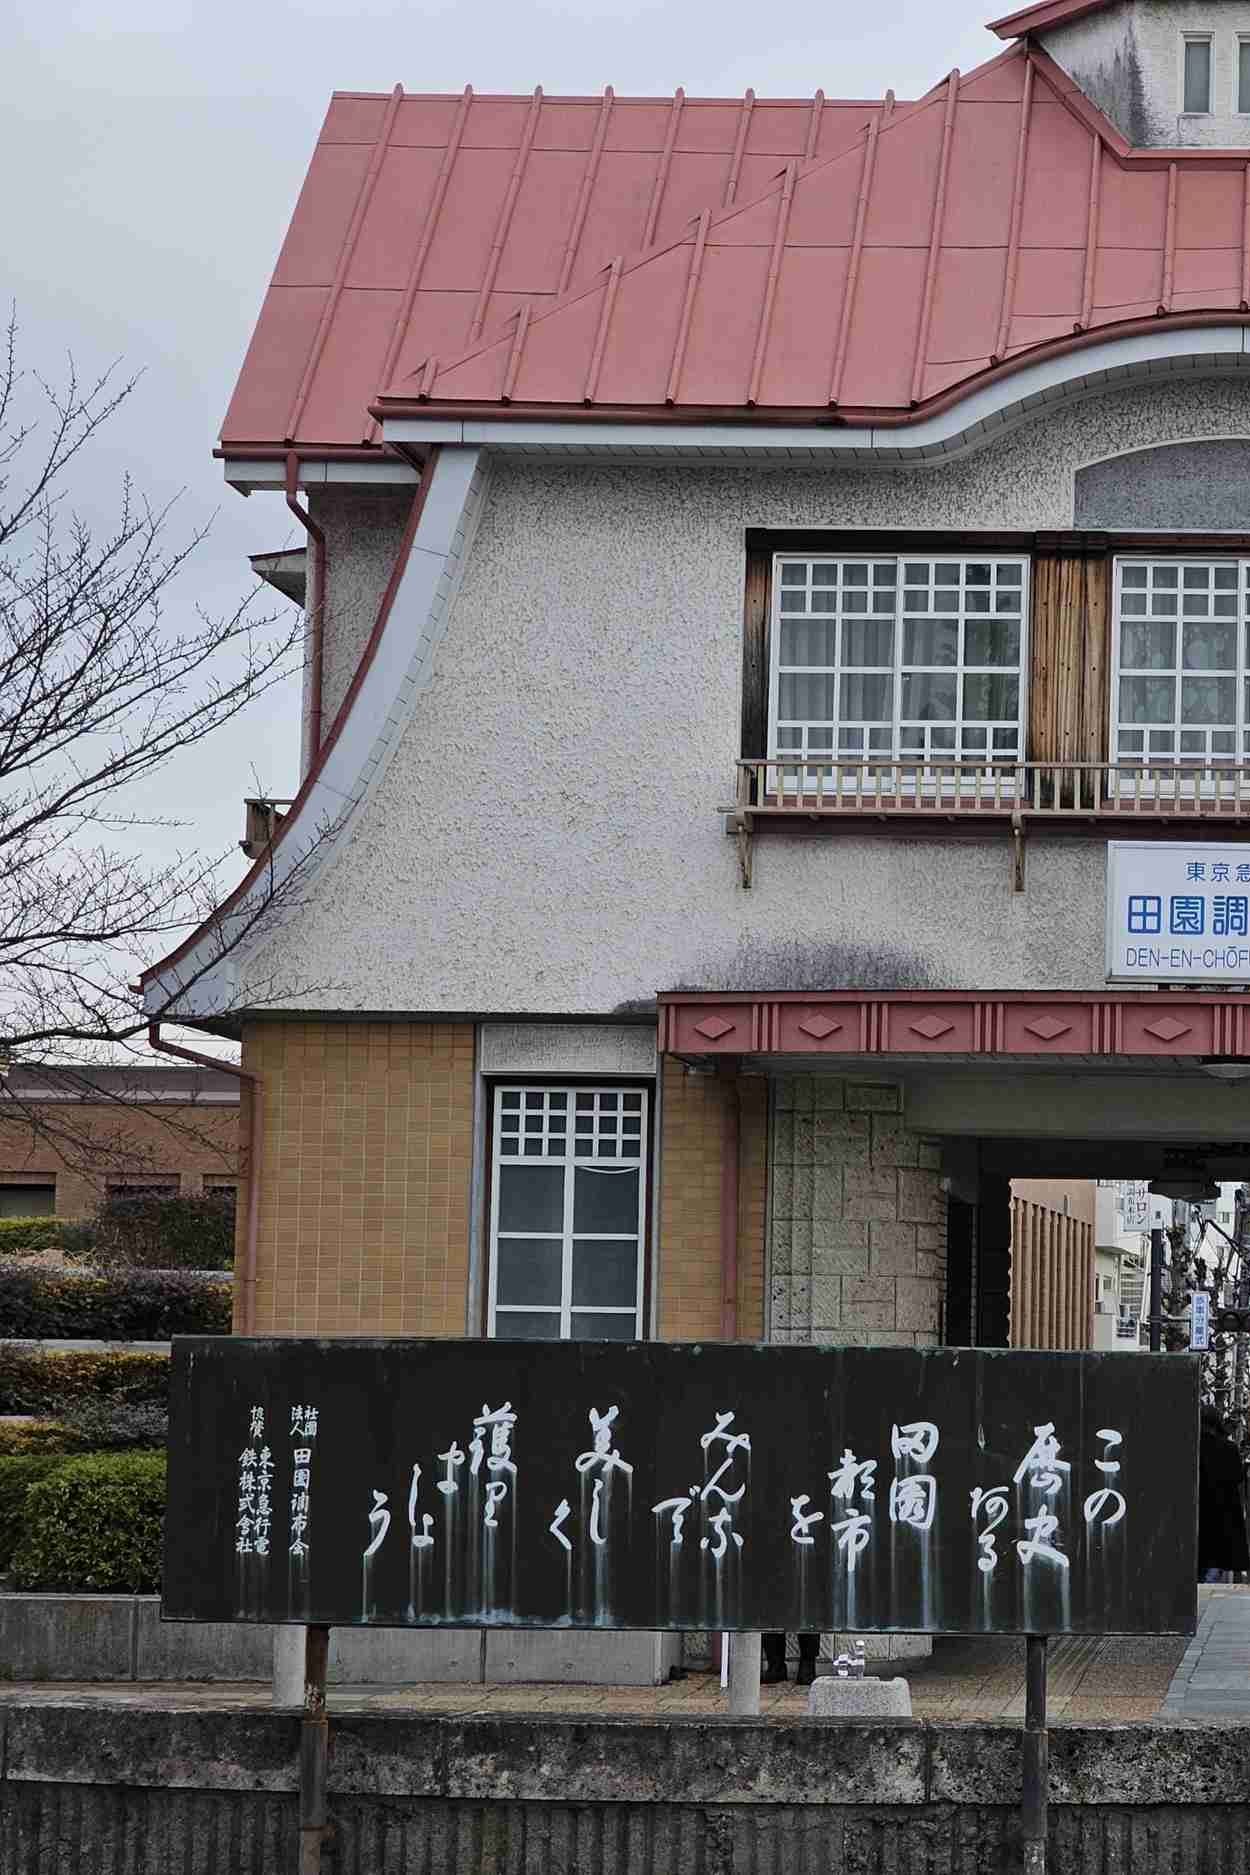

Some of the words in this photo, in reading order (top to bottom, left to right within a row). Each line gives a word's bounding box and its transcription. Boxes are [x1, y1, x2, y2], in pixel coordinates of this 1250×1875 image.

[575, 1404, 634, 1545] 美し
[790, 1494, 825, 1545] を
[889, 1421, 940, 1530] 田園
[1083, 1428, 1127, 1525] この
[549, 1498, 573, 1551] く
